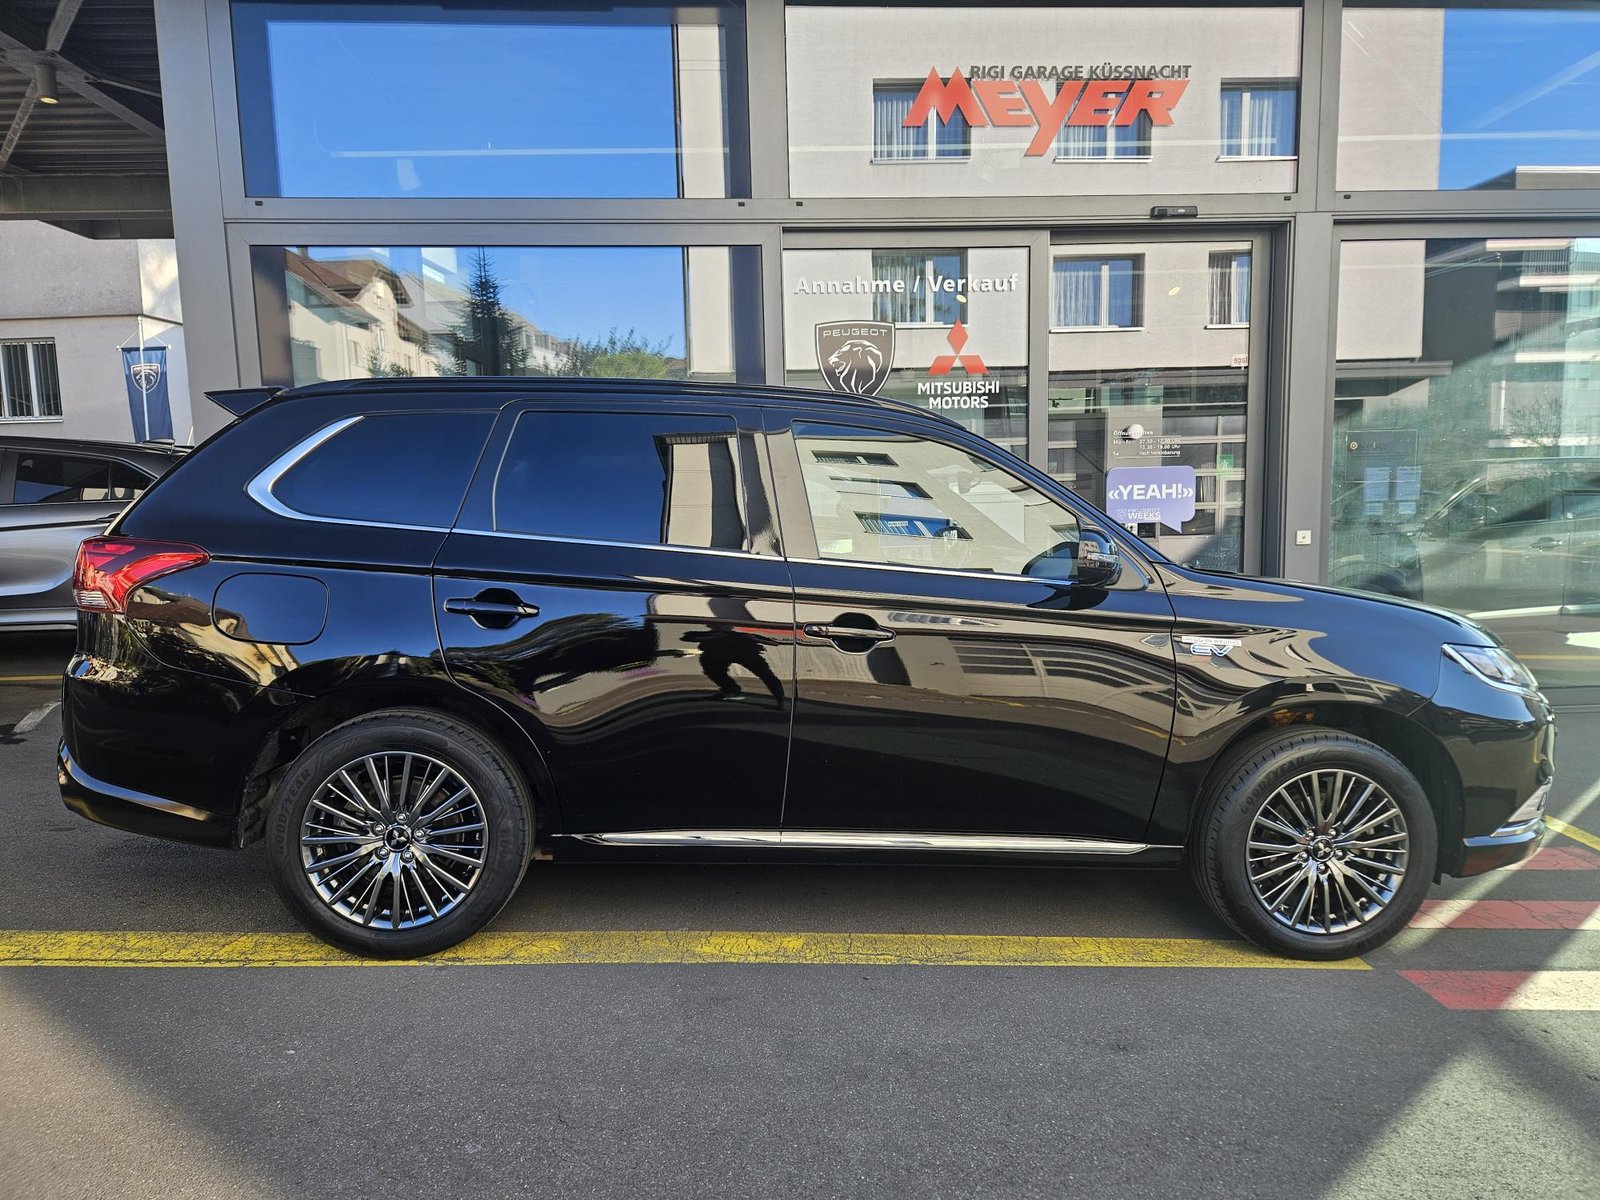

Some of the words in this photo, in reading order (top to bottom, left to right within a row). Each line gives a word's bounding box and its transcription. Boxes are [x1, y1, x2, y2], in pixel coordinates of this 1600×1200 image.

[969, 65, 1005, 79] RIGI
[1009, 65, 1084, 79] GARAGE
[1089, 62, 1192, 79] KÜSSNACHT
[902, 66, 1190, 157] MEYER
[794, 275, 906, 295] Annahme
[928, 272, 1019, 292] Verkauf
[823, 328, 888, 338] PEUGEOT
[917, 380, 1000, 395] MITSUBISHI
[929, 396, 989, 409] MOTORS
[1128, 511, 1161, 520] WEEKS
[1190, 643, 1234, 657] EV
